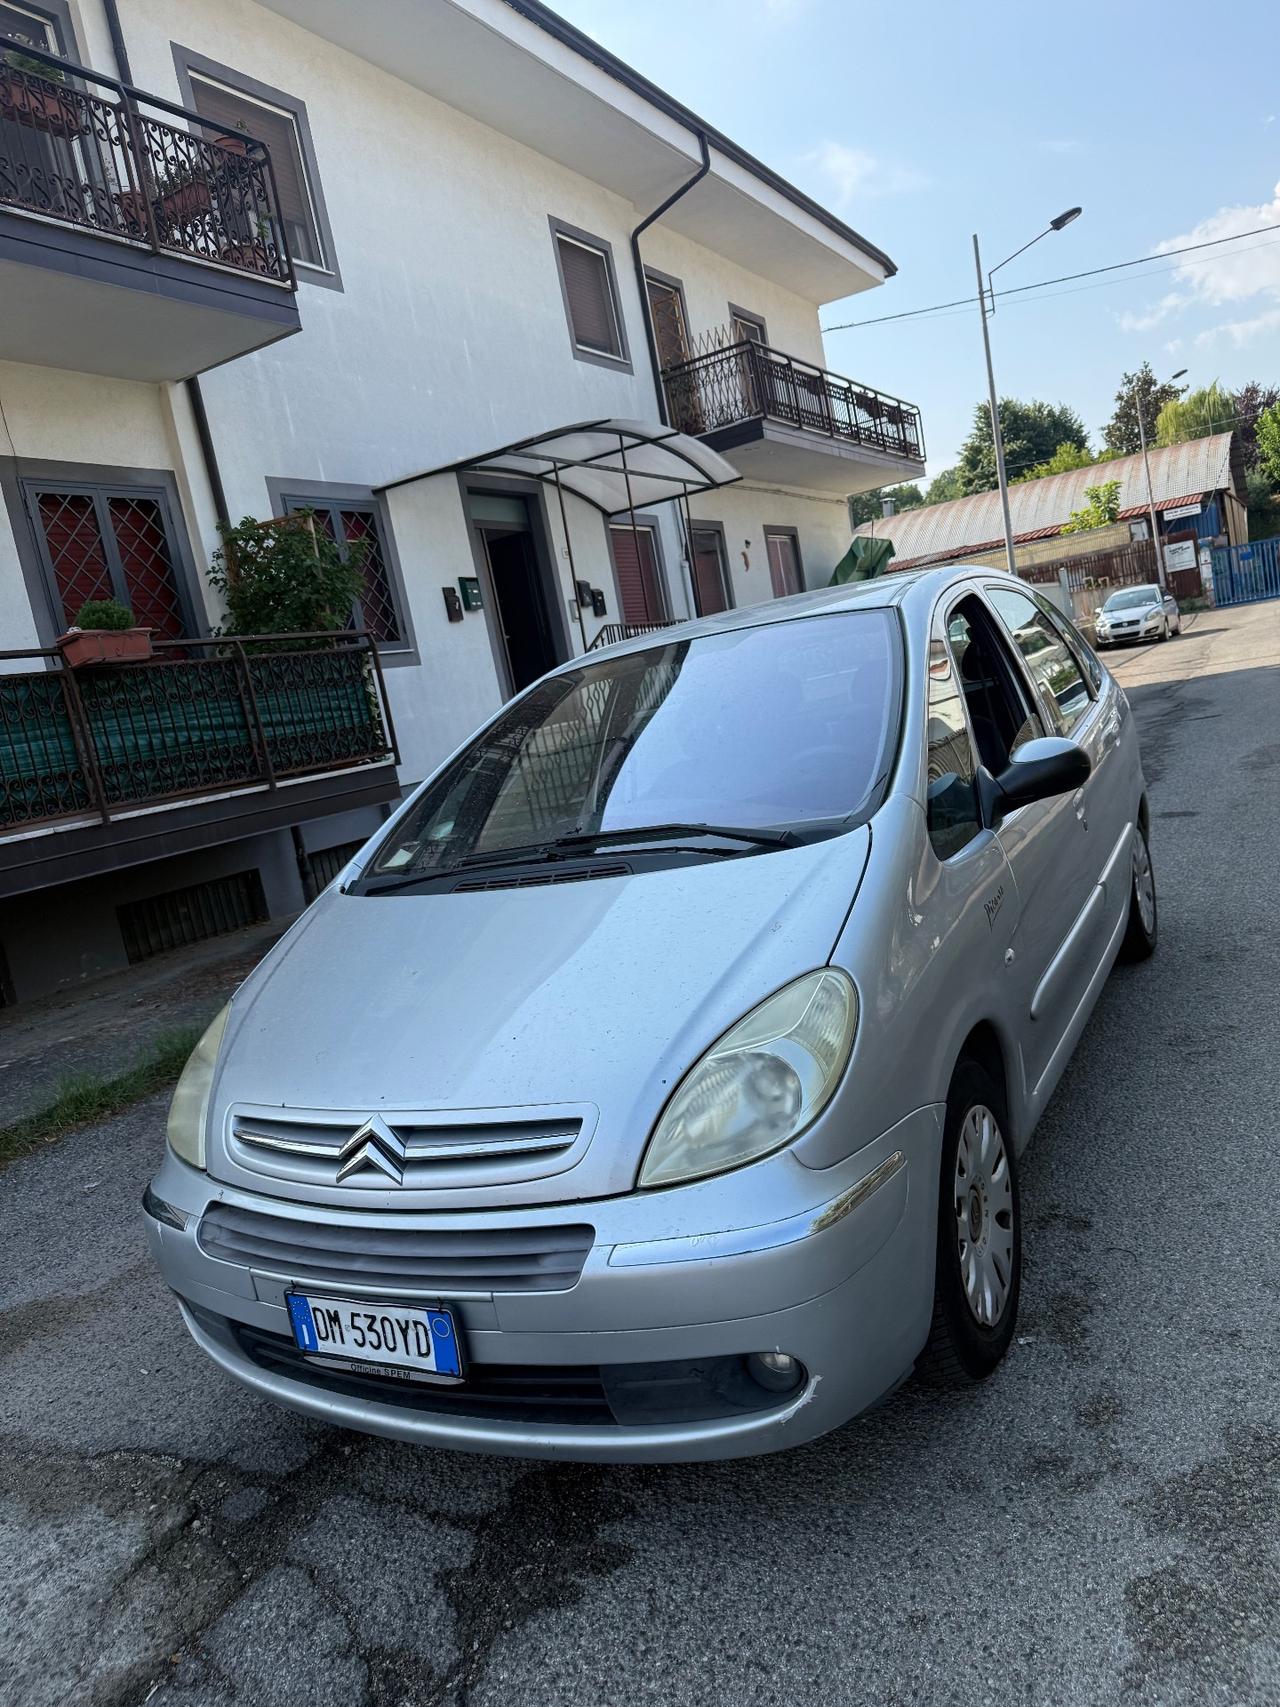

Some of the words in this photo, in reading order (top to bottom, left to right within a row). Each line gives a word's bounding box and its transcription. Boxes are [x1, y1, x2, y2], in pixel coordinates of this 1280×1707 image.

[312, 1307, 345, 1344] DM
[351, 1312, 431, 1358] 530YD
[351, 1363, 382, 1375] Officine
[384, 1368, 411, 1380] SPEM
